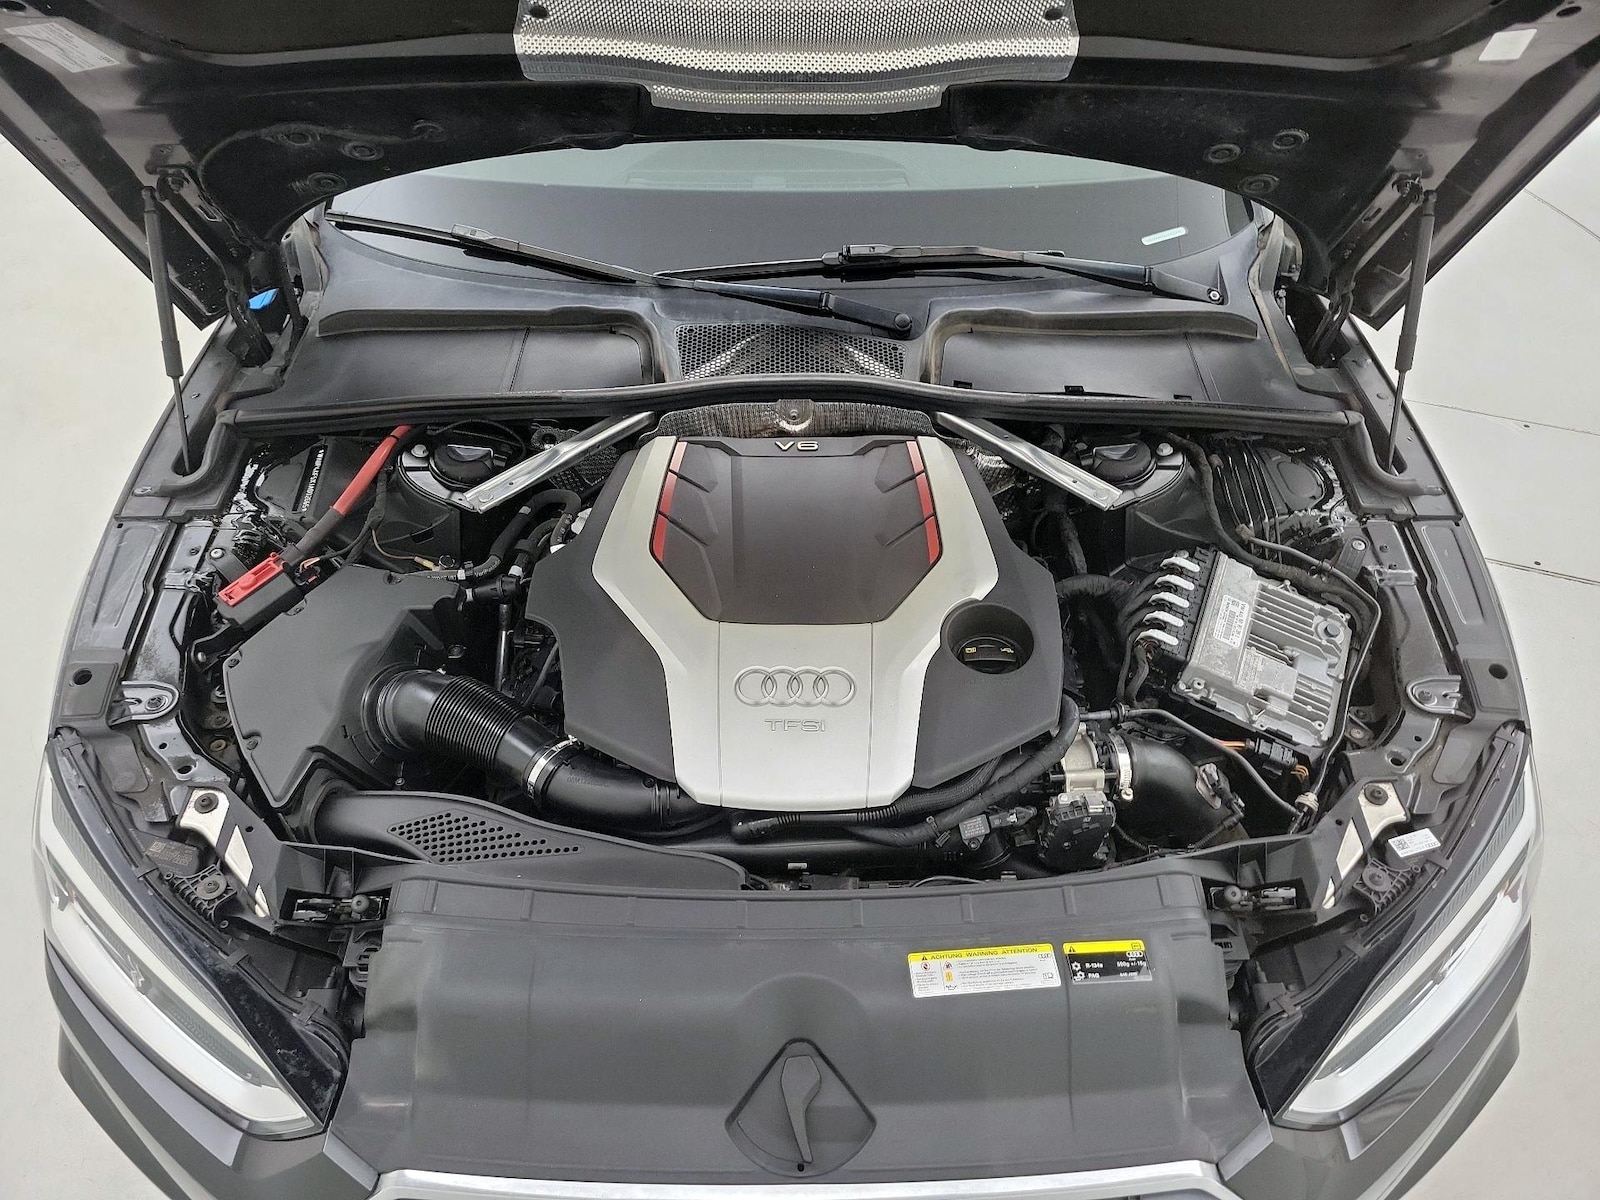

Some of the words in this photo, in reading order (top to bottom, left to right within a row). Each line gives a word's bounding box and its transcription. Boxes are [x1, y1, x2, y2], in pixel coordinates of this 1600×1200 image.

[775, 441, 819, 451] V6
[764, 719, 825, 732] TFSI
[930, 953, 962, 961] ACHTUNG
[966, 950, 998, 958] WARNING
[1001, 947, 1038, 956] ATTENTION
